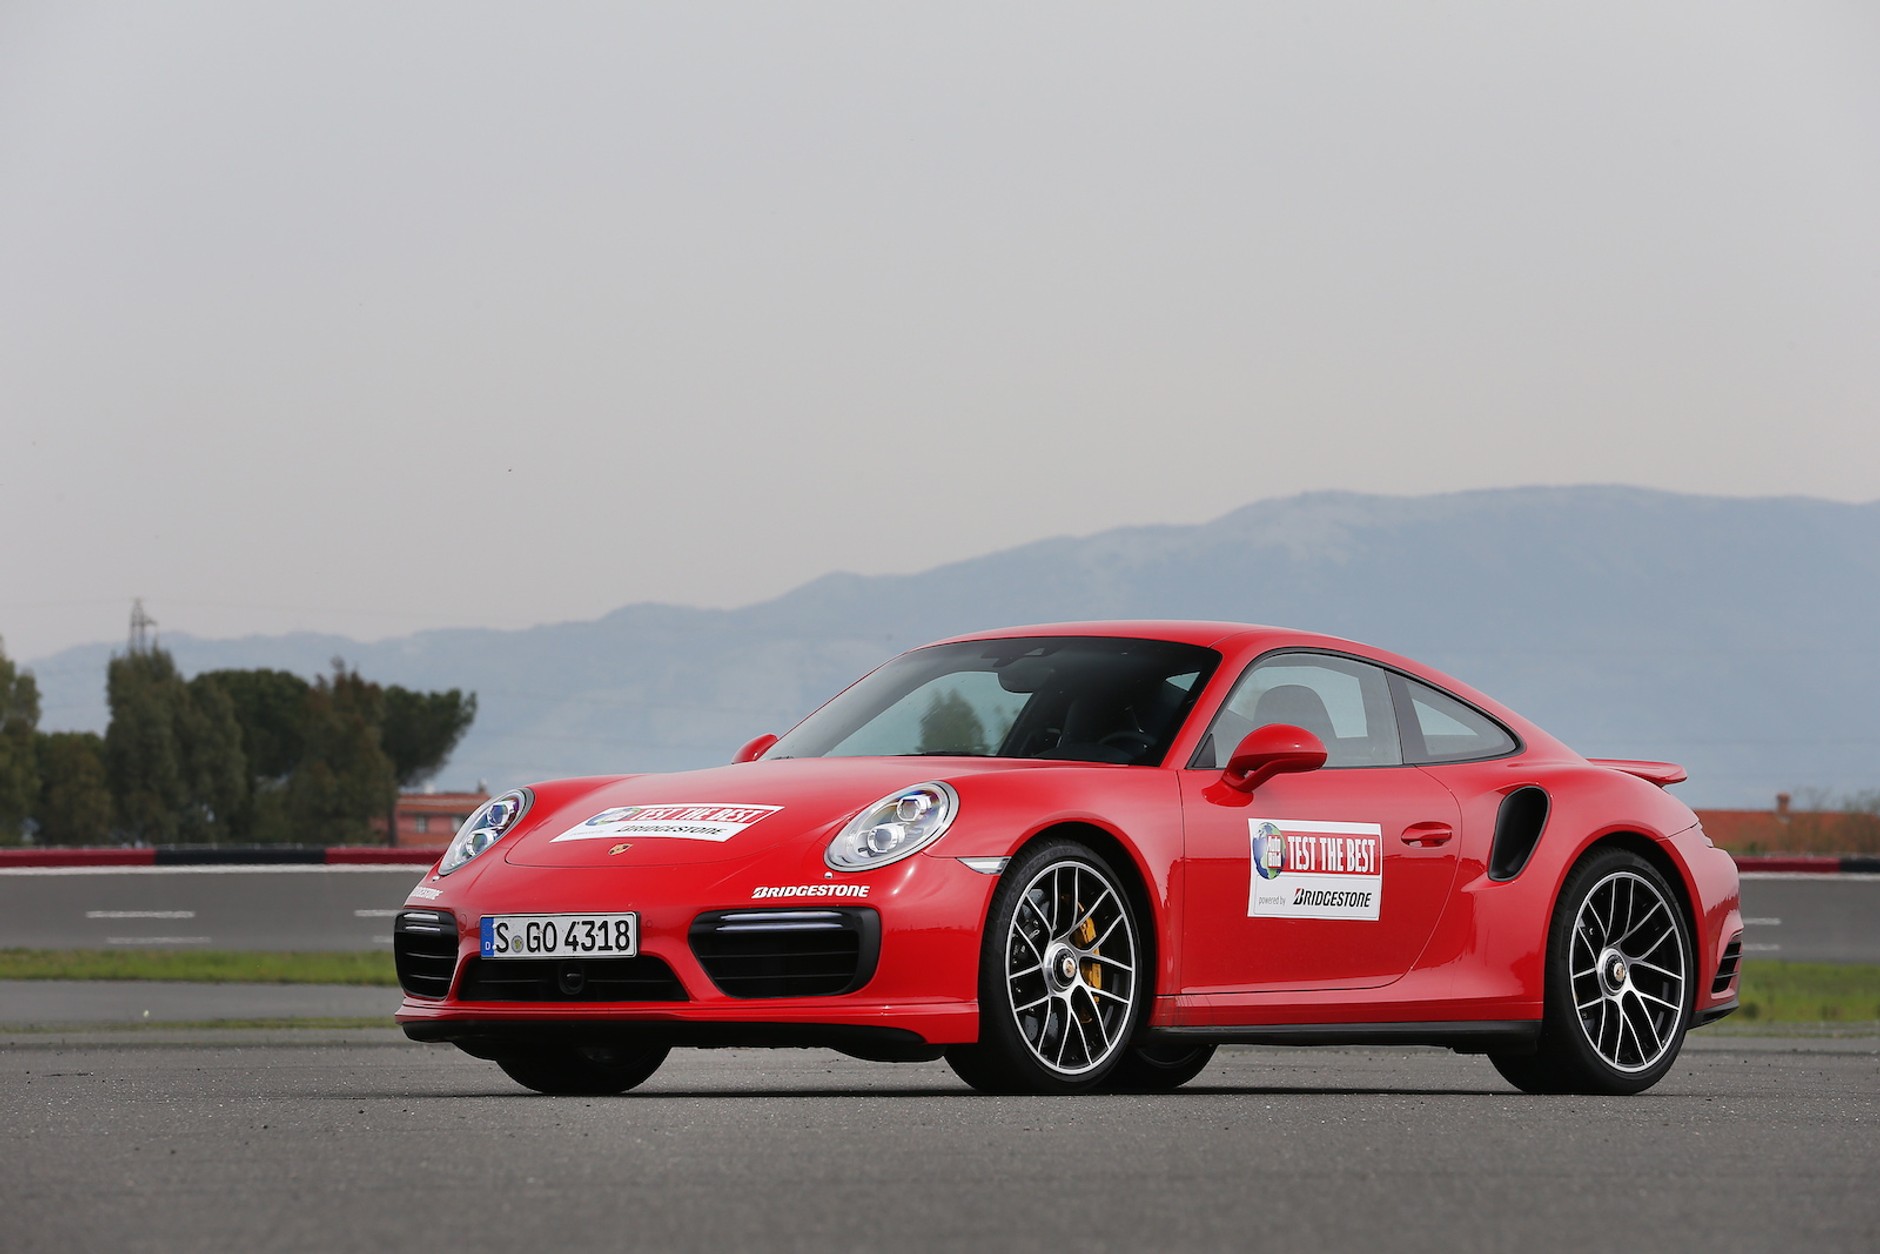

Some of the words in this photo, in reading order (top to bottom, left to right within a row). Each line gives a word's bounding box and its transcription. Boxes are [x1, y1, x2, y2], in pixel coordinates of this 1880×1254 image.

[630, 808, 682, 821] TEST
[671, 808, 721, 821] THE
[705, 808, 765, 824] BEST
[616, 825, 727, 835] BRIDGESTONE
[1288, 835, 1316, 871] TEST
[1319, 837, 1344, 872] THE
[1346, 838, 1376, 873] BEST
[751, 884, 871, 899] BRIDGESTONE
[1293, 888, 1372, 908] BRIDGESTONE
[1258, 895, 1279, 906] powered
[1279, 896, 1286, 907] by
[495, 922, 509, 953] S
[526, 921, 557, 953] GO
[564, 920, 630, 953] 4318
[485, 941, 490, 951] D
